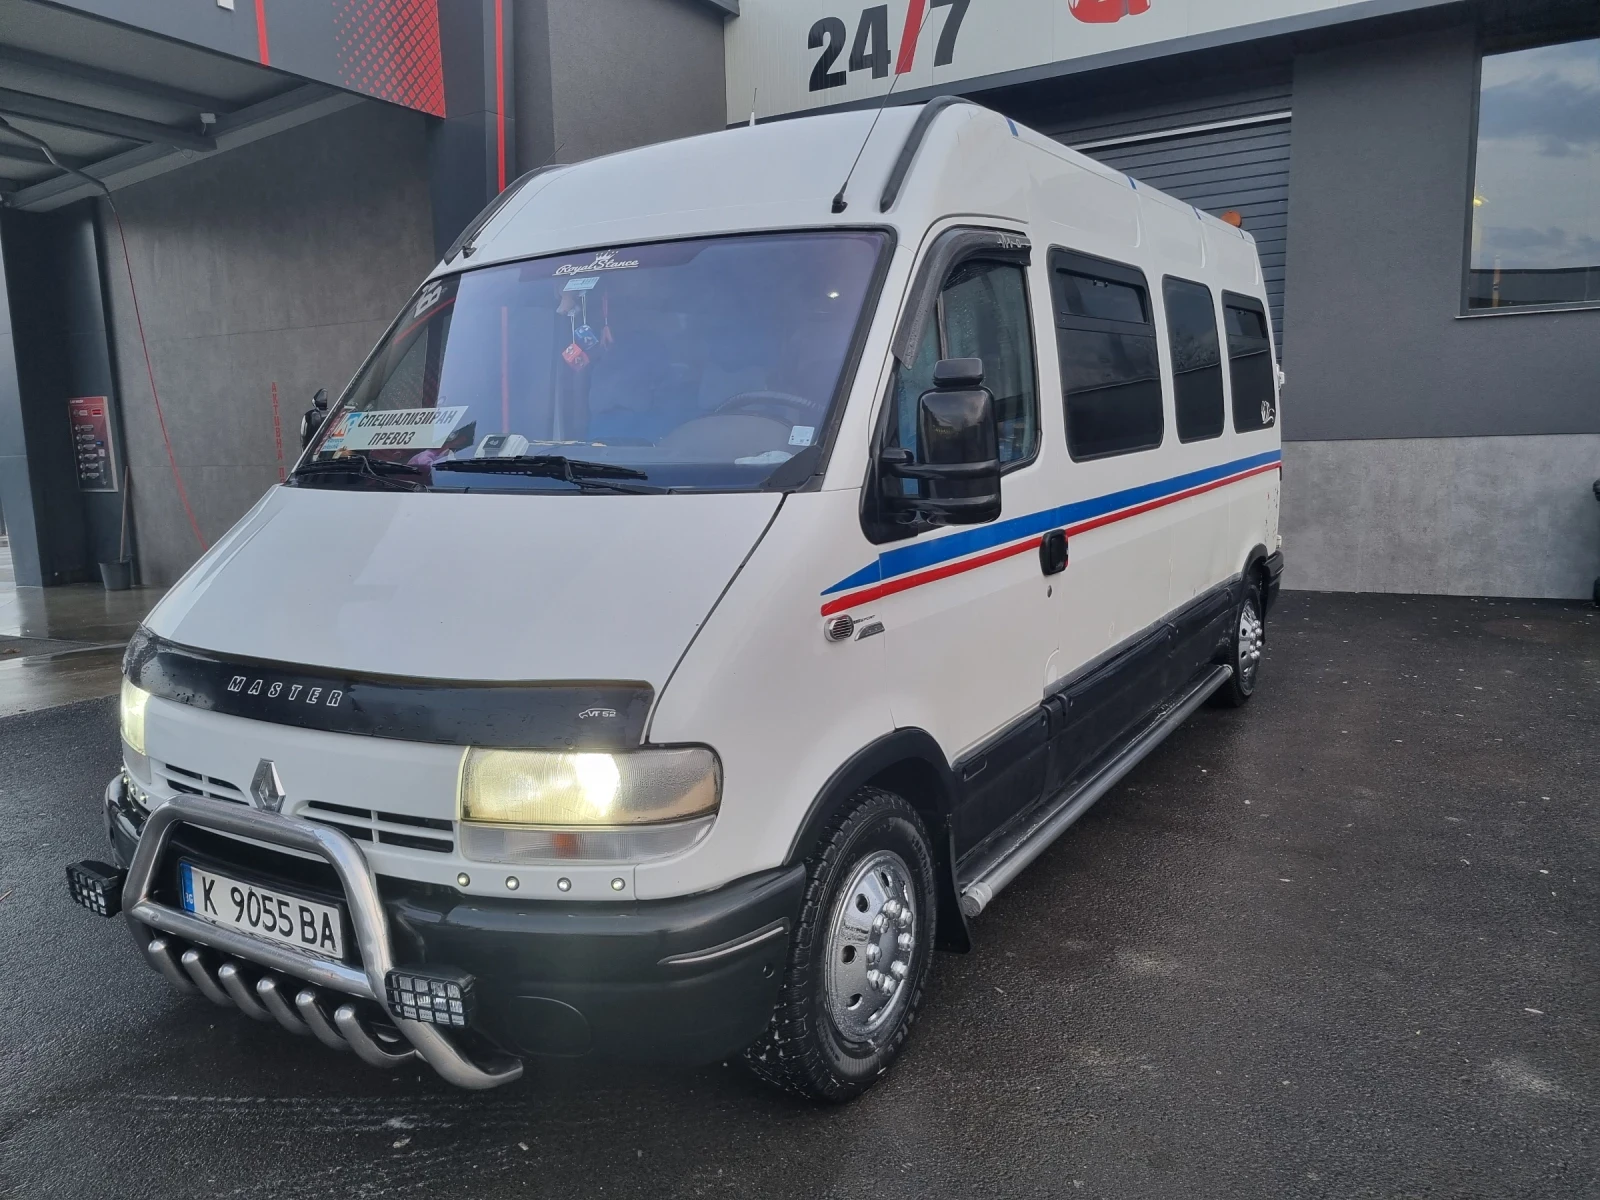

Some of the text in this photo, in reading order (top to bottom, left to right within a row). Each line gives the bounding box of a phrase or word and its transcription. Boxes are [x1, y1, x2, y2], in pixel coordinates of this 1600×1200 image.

[808, 0, 970, 92] 24/7
[357, 410, 458, 428] СПЕЦИАЛИЗИРАН
[368, 431, 416, 446] ПРЕВОЗ
[227, 675, 343, 706] MASTER
[230, 886, 294, 937] 9055
